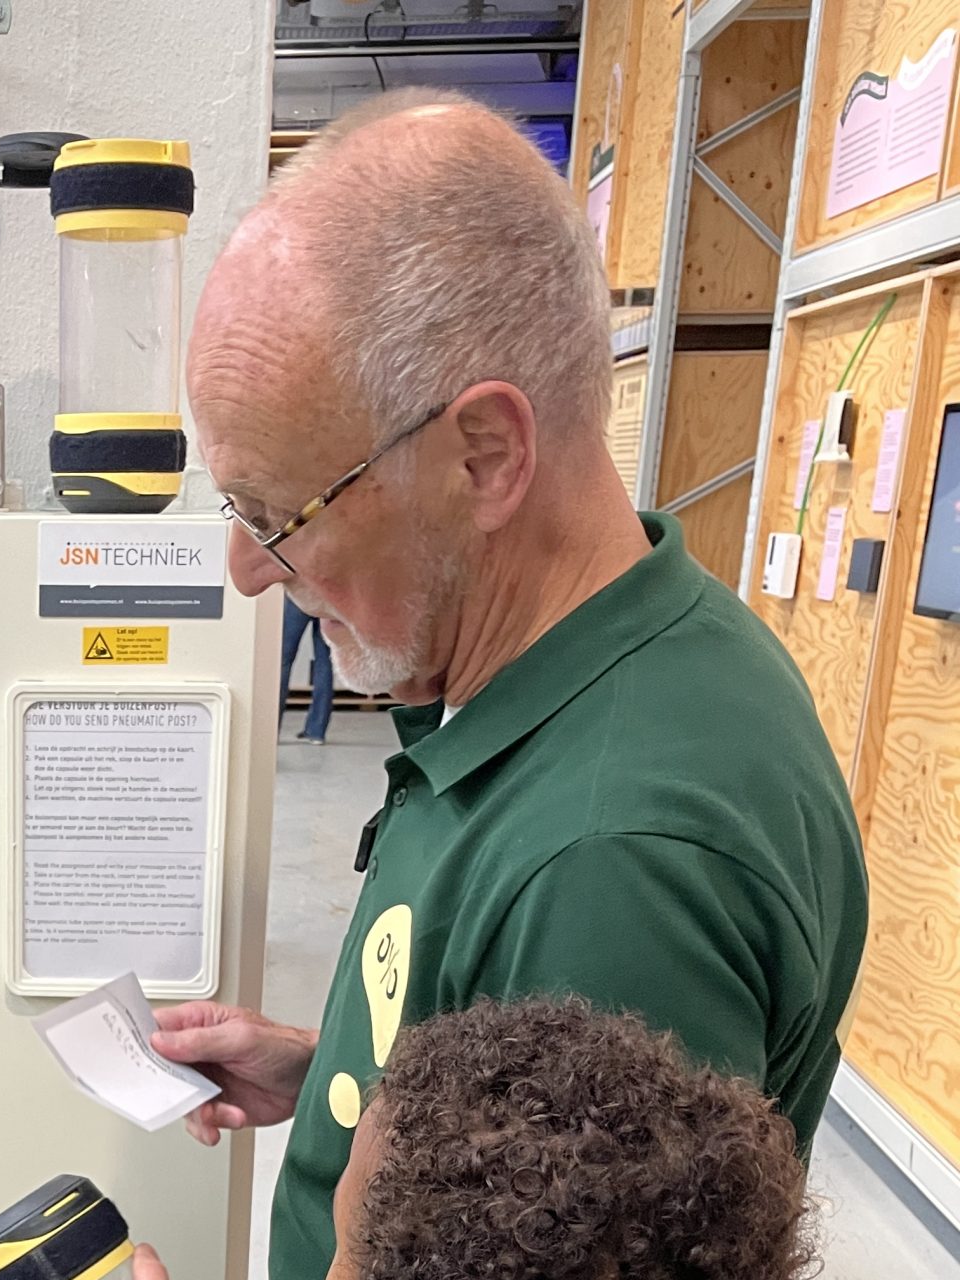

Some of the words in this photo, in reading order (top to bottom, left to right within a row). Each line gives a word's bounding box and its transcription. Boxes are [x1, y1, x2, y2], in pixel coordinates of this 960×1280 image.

[25, 714, 46, 726] HOW
[50, 714, 61, 726] DO
[64, 714, 82, 726] YOU
[84, 714, 109, 726] SEND
[112, 714, 164, 727] PNEUMATIC
[168, 715, 197, 727] POST?
